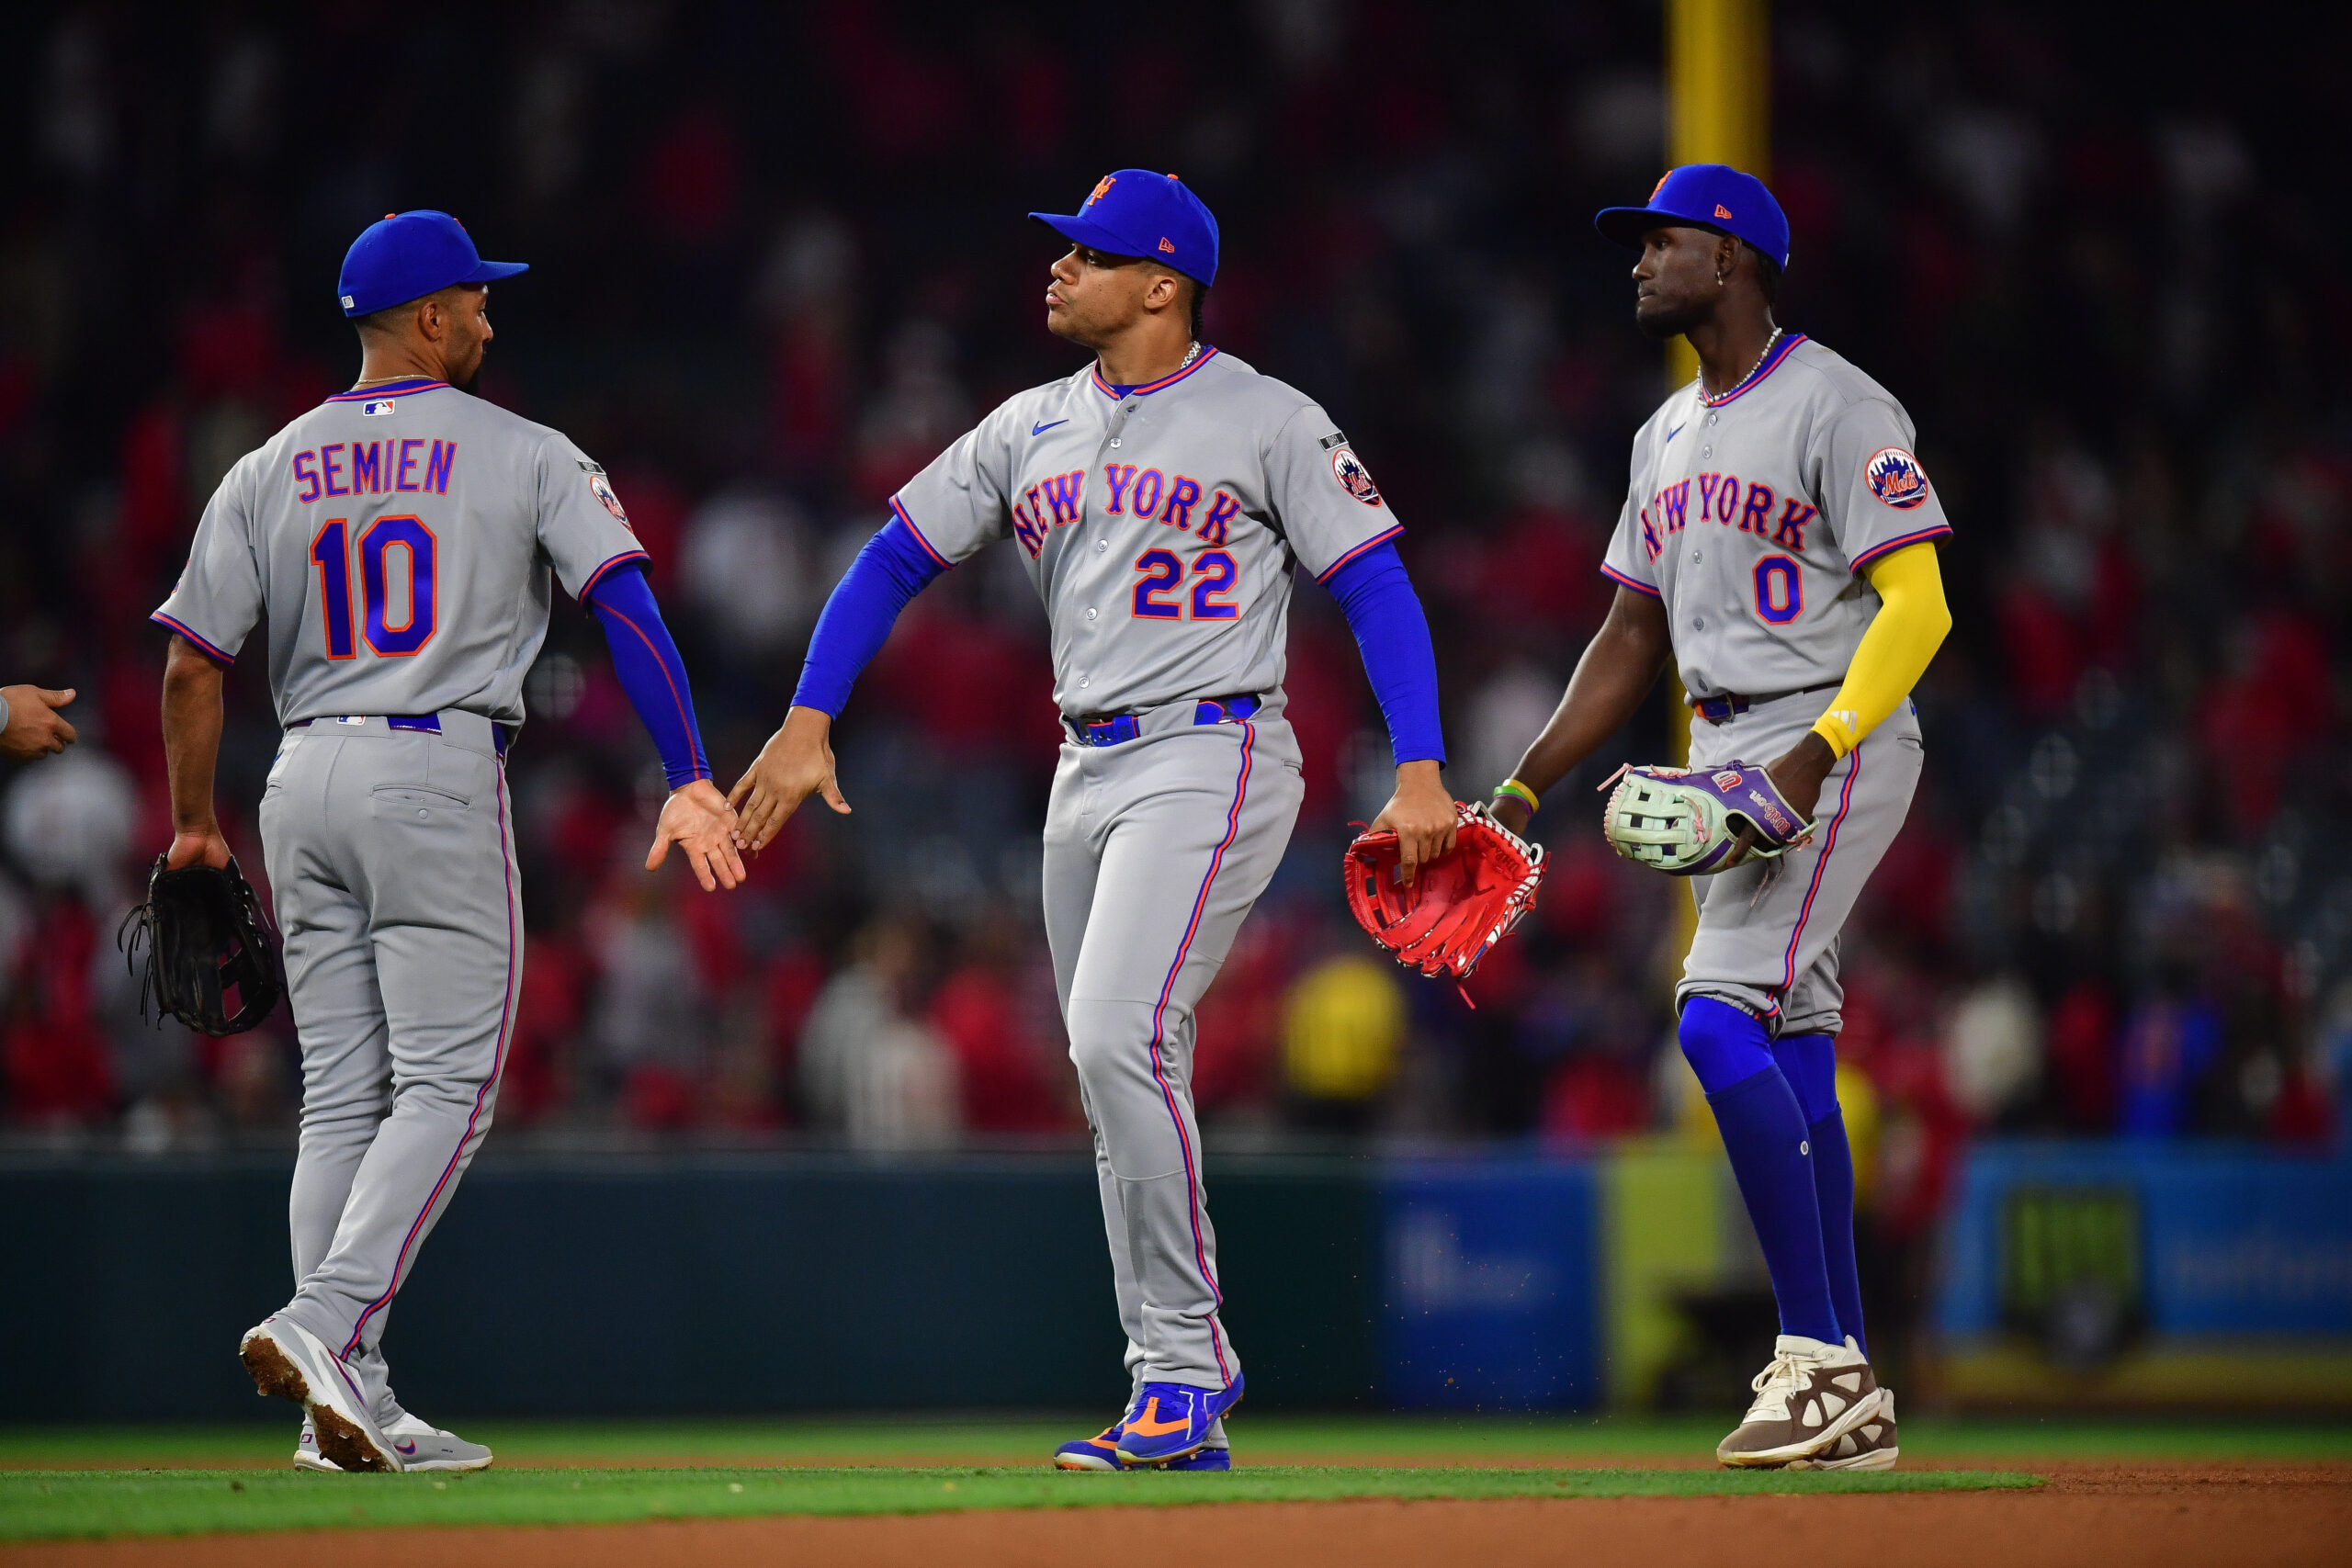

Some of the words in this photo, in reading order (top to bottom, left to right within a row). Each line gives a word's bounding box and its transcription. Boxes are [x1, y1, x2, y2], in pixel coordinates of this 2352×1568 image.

[292, 438, 458, 504] SEMIEN
[1882, 469, 1918, 497] Mets
[1012, 469, 1085, 559] NEW
[1104, 463, 1241, 548] YORK
[1698, 471, 1818, 552] YORK
[309, 513, 437, 660] 10
[1131, 547, 1240, 621] 22
[1752, 553, 1804, 626] 0
[1748, 788, 1791, 836] Wilson
